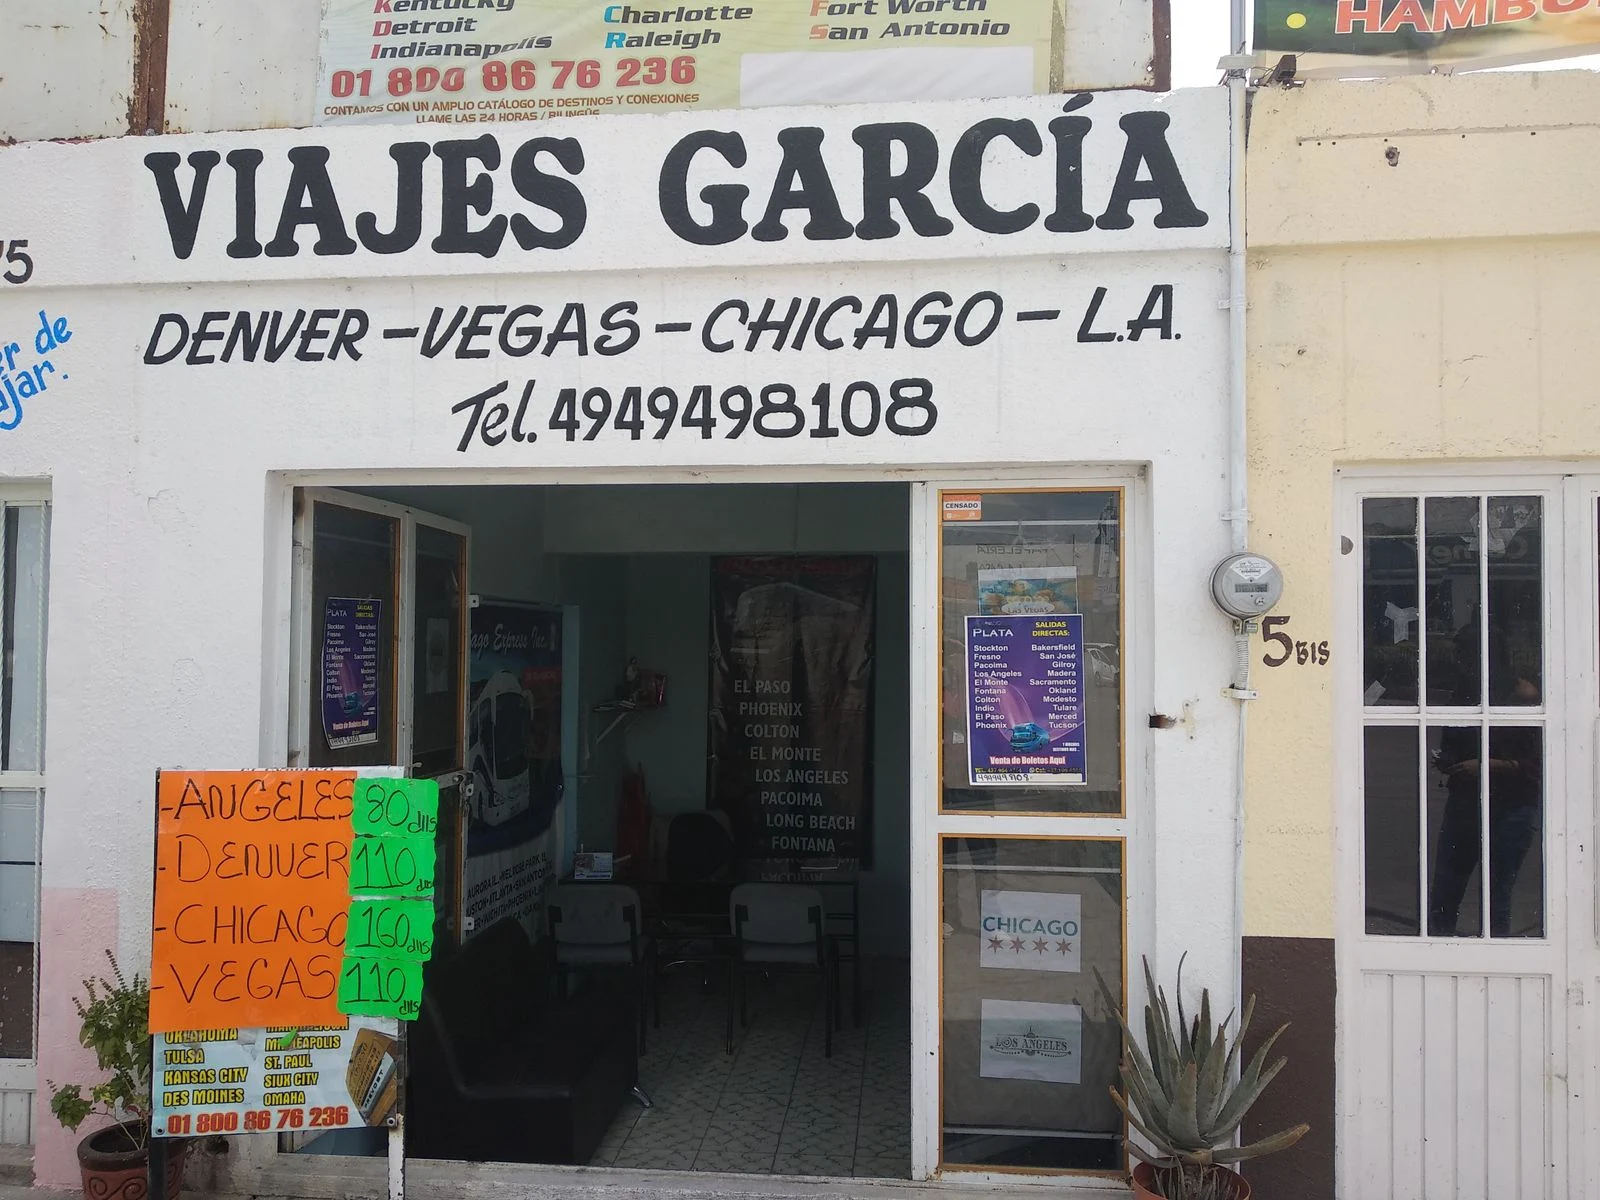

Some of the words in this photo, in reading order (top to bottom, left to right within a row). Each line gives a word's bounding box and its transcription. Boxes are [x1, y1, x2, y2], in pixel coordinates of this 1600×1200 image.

[603, 5, 753, 24] Charlotte
[810, 0, 878, 17] Fort
[888, 0, 987, 15] Worth
[372, 17, 478, 37] Detroit
[809, 23, 869, 40] San
[879, 19, 1011, 39] Antonio
[604, 28, 721, 50] Raleigh
[370, 36, 553, 60] Indianapolis
[331, 69, 373, 98] 01
[387, 66, 466, 97] 800
[482, 60, 536, 92] 86
[551, 60, 601, 90] 76
[615, 55, 696, 88] 236
[324, 104, 384, 116] CONTAMOS
[386, 102, 410, 112] CON
[412, 101, 429, 112] UN
[432, 101, 475, 112] AMPLIO
[477, 98, 535, 110] CATÁLOGO
[539, 98, 554, 109] DE
[557, 96, 613, 108] DESTINOS
[615, 95, 625, 104] Y
[626, 93, 700, 105] CONEXIONES
[416, 114, 452, 124] LLAME
[455, 113, 476, 122] LAS
[479, 112, 496, 122] 24
[498, 111, 537, 122] HORAS
[144, 133, 587, 260] VIAJES
[658, 92, 1209, 245] GARCÍA
[35, 310, 73, 355] de
[144, 308, 369, 365] DENVER
[418, 301, 641, 360] VEGAS
[701, 290, 1003, 354] CHICAGO
[1076, 284, 1182, 343] L.A.
[451, 379, 538, 453] Tel.
[549, 377, 938, 443] 4949498108
[973, 628, 1014, 638] PLATA
[1035, 621, 1066, 629] SALIDAS
[974, 644, 1008, 652] Stockton
[1031, 644, 1076, 652] Bakersfield
[1261, 615, 1293, 668] 5
[1295, 639, 1331, 666] BIS
[1040, 652, 1055, 660] San
[1056, 652, 1076, 660] José
[1052, 661, 1076, 670] Gilroy
[974, 670, 989, 678] Los
[990, 670, 1022, 679] Angeles
[1029, 678, 1077, 686] Sacramento
[733, 679, 751, 693] EL
[755, 679, 791, 694] PASO
[975, 696, 1001, 704] Colton
[1053, 704, 1078, 712] Tulare
[739, 702, 804, 717] PHOENIX
[744, 723, 800, 739] COLTON
[750, 746, 766, 761] EL
[771, 746, 821, 762] MONTE
[990, 756, 1010, 765] Venta
[1012, 756, 1020, 765] de
[1021, 756, 1048, 765] Boletos
[755, 769, 781, 783] LOS
[785, 769, 849, 785] ANGELES
[366, 784, 410, 826] 80
[760, 791, 823, 807] PACOIMA
[766, 814, 804, 829] LONG
[809, 815, 856, 831] BEACH
[771, 836, 836, 852] FONTANA
[354, 842, 416, 889] 110
[355, 906, 410, 948] 160
[982, 916, 1078, 937] CHICAGO
[345, 962, 406, 1004] 110
[265, 1035, 341, 1052] MIEAPOLIS
[995, 1036, 1018, 1048] LOS
[1022, 1038, 1068, 1051] ANGELES
[164, 1048, 205, 1065] TULSA
[264, 1056, 282, 1070] ST.
[283, 1054, 312, 1069] PAUL
[163, 1068, 217, 1087] KANSAS
[218, 1066, 249, 1084] CITY
[264, 1073, 292, 1089] SIUX
[293, 1071, 319, 1087] CITY
[163, 1090, 190, 1108] DES
[192, 1087, 245, 1106] MOINES
[263, 1091, 305, 1107] OMAHA
[167, 1114, 192, 1135] 01
[196, 1111, 239, 1133] 800
[244, 1109, 271, 1131] 86
[276, 1108, 304, 1129] 76
[309, 1106, 349, 1128] 236
